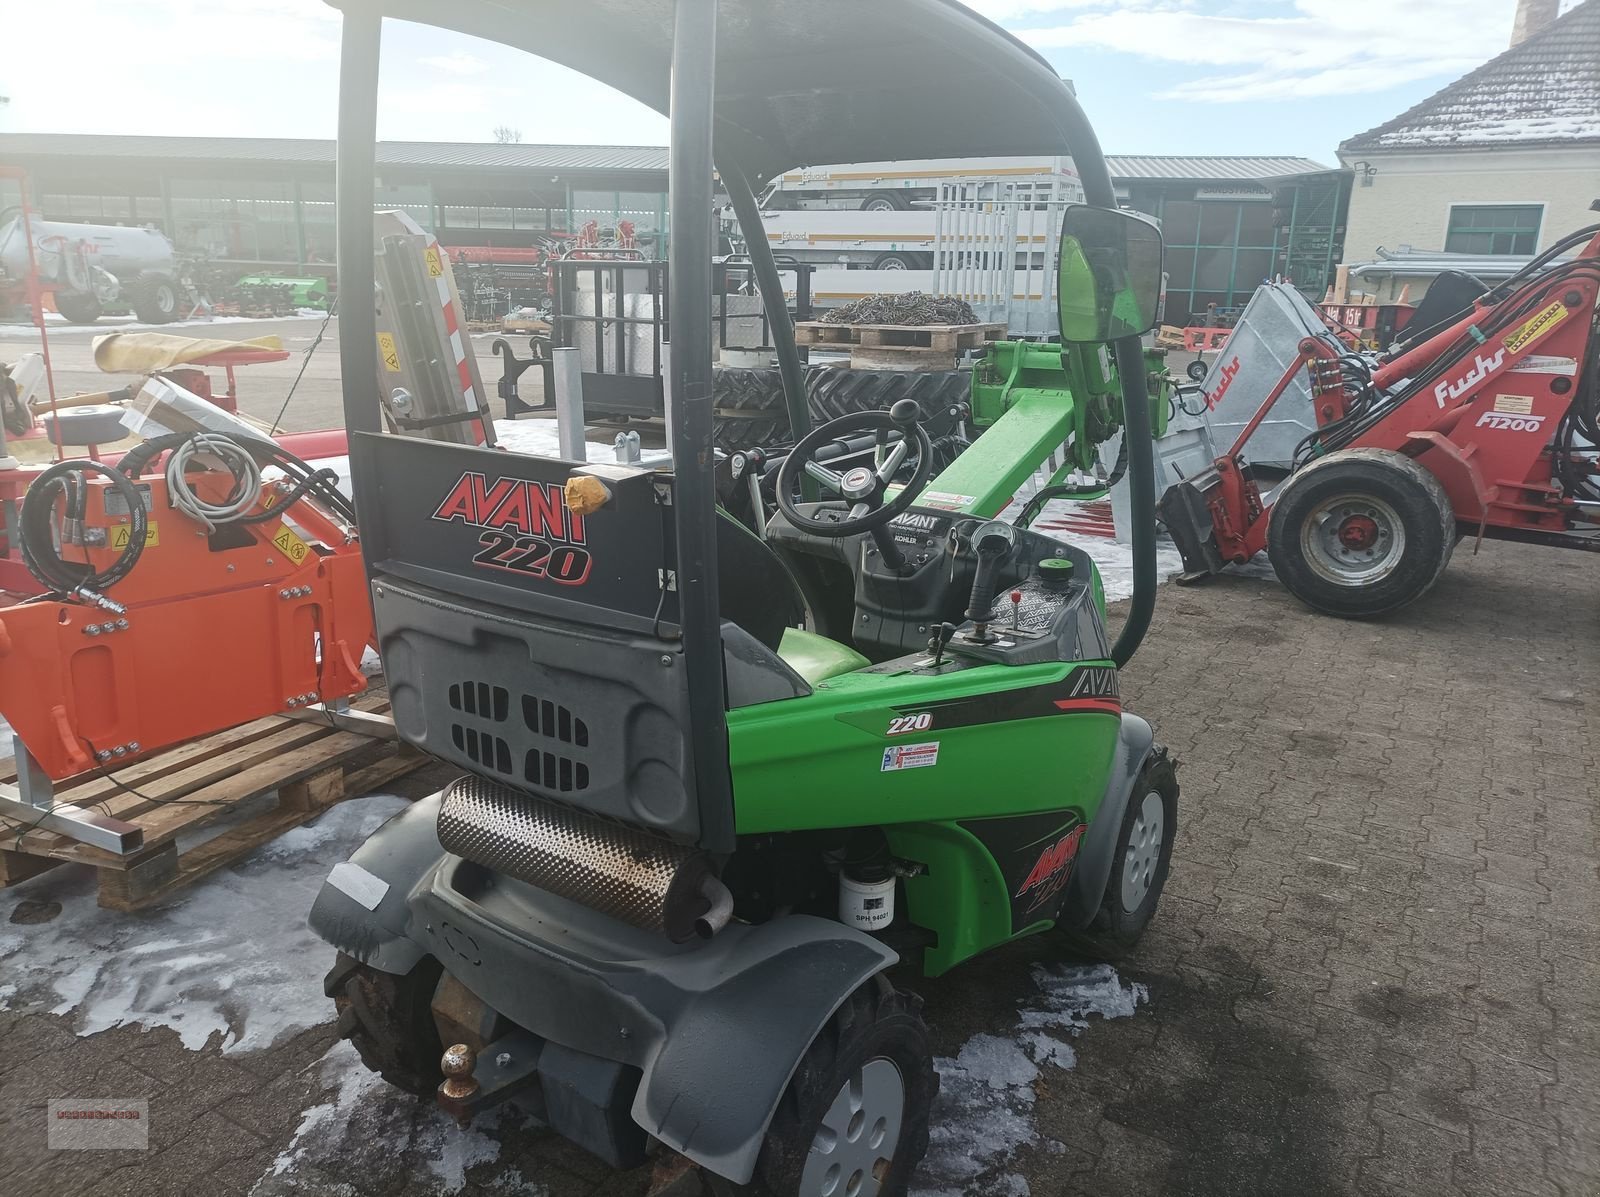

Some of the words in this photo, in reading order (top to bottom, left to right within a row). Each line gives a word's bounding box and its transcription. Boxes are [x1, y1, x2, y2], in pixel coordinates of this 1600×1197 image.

[803, 171, 828, 180] Eduard
[782, 231, 807, 240] Eduard
[1203, 355, 1240, 412] Fuchs
[1434, 347, 1506, 409] Fuchs
[1475, 411, 1546, 433] F1200
[888, 512, 938, 529] AVANT
[894, 535, 917, 545] KOHLER
[472, 530, 593, 586] 220
[886, 712, 933, 735] 220
[855, 914, 871, 922] SPH
[872, 911, 889, 922] 94021
